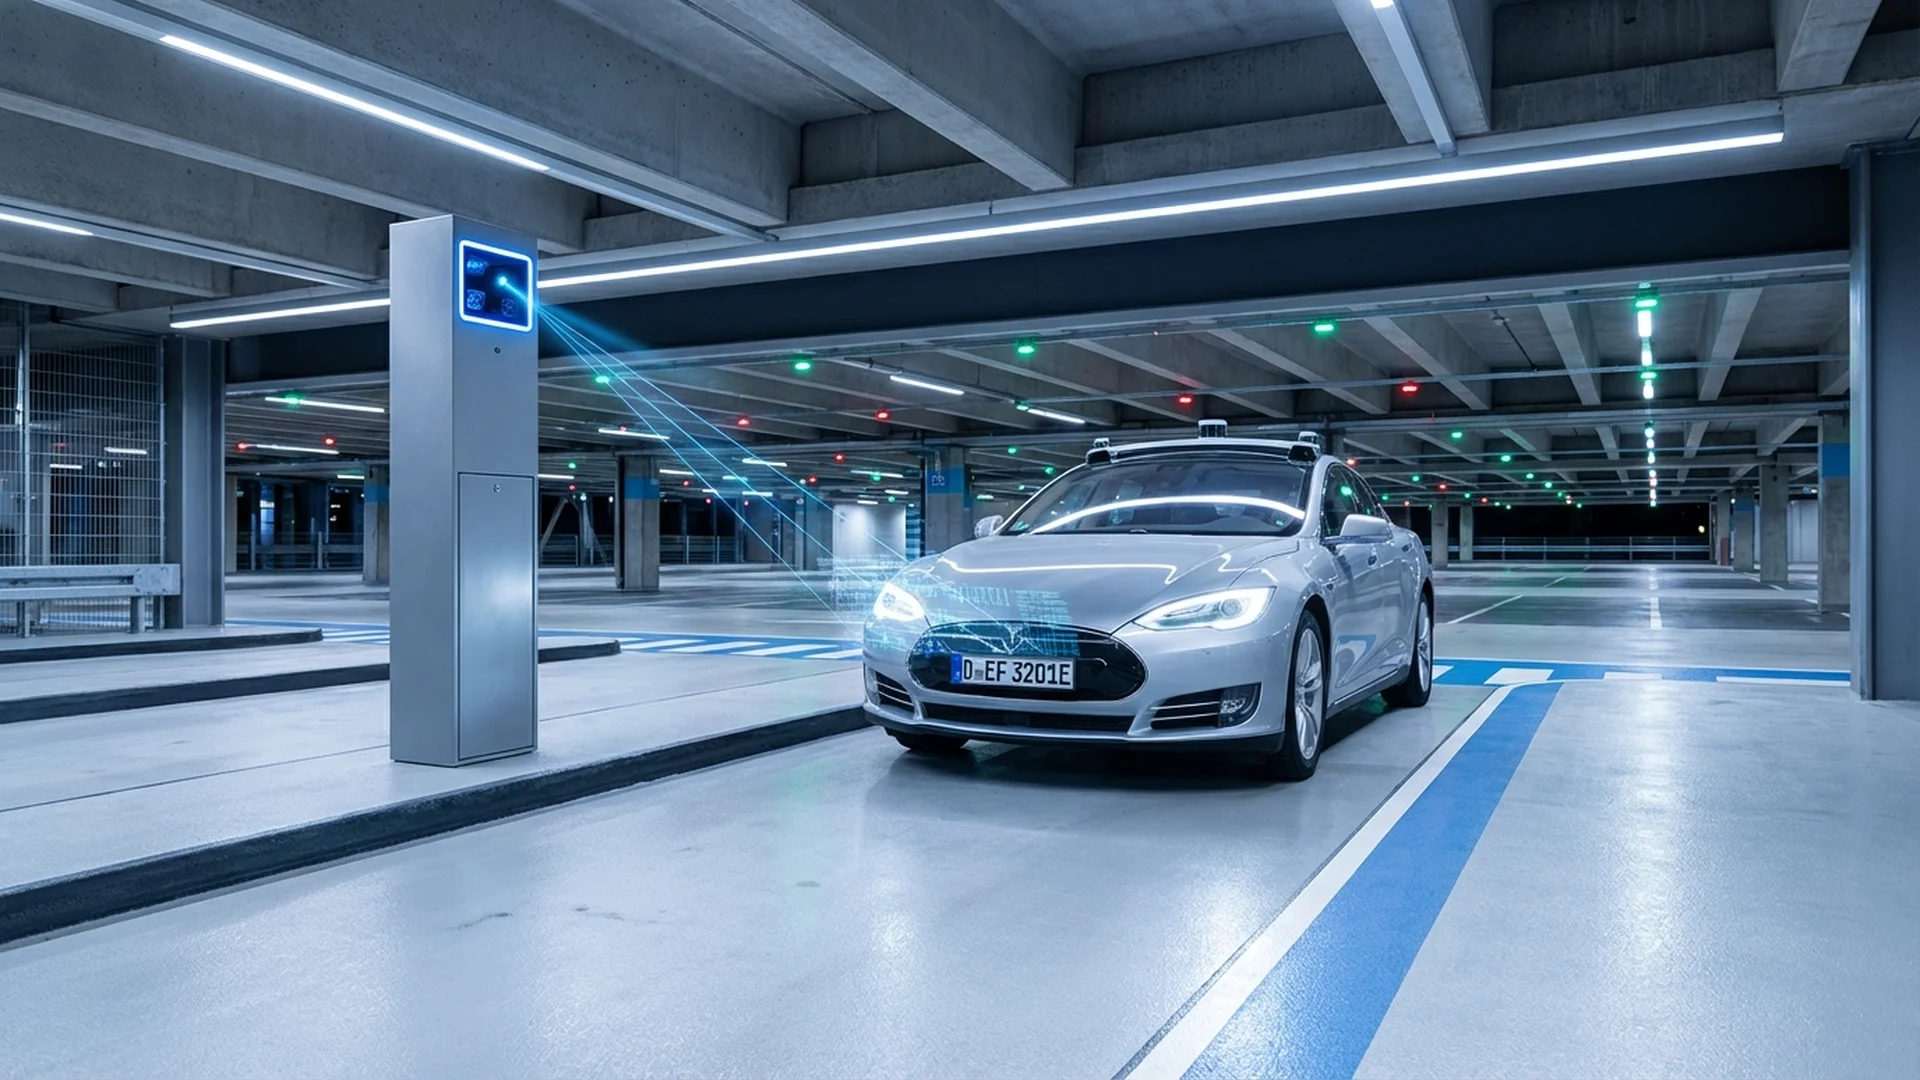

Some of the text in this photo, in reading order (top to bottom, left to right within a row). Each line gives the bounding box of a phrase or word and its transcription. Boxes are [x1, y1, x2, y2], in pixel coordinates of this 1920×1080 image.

[963, 659, 1071, 686] D EF 3201E
